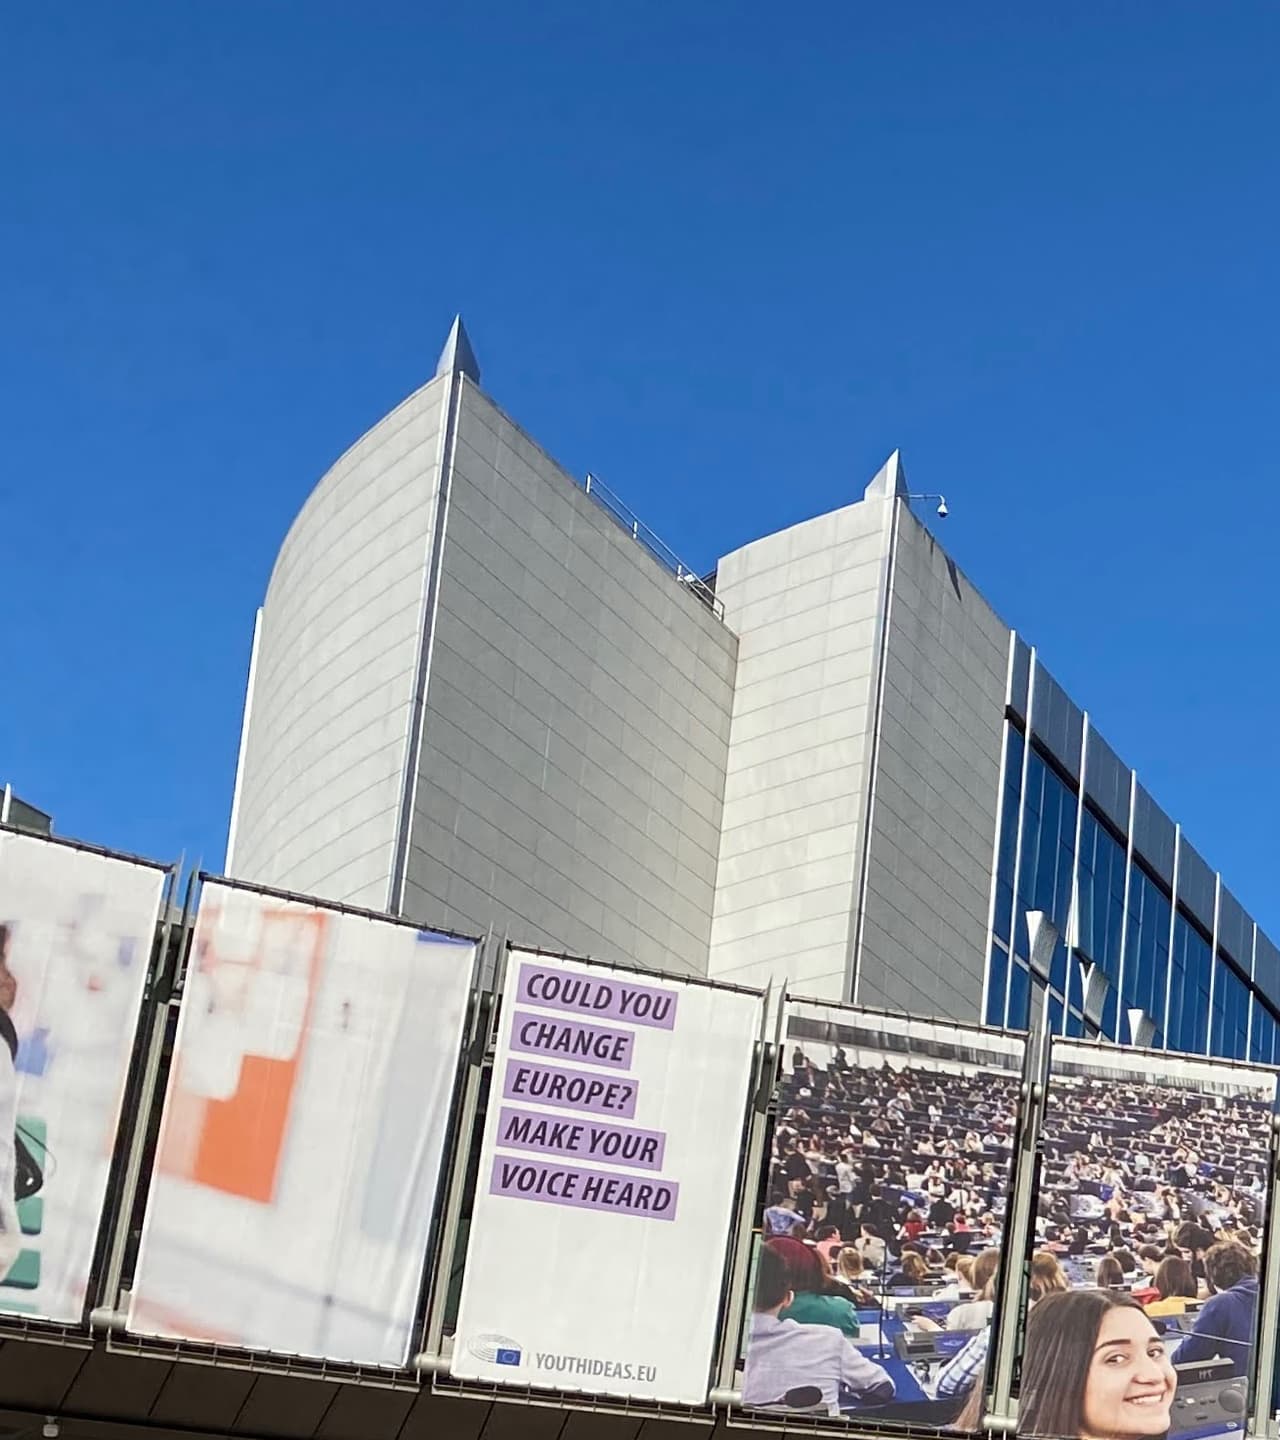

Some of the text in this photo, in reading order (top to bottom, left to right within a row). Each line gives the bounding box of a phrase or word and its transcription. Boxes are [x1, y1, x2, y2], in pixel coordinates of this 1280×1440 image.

[527, 974, 672, 1020] COULD YOU
[520, 1022, 628, 1061] CHANGE
[512, 1068, 632, 1110] EUROPE?
[504, 1116, 658, 1162] MAKE YOUR
[501, 1164, 671, 1211] VOICE HEARD
[536, 1352, 656, 1382] YOUTHIDEAS.EU
